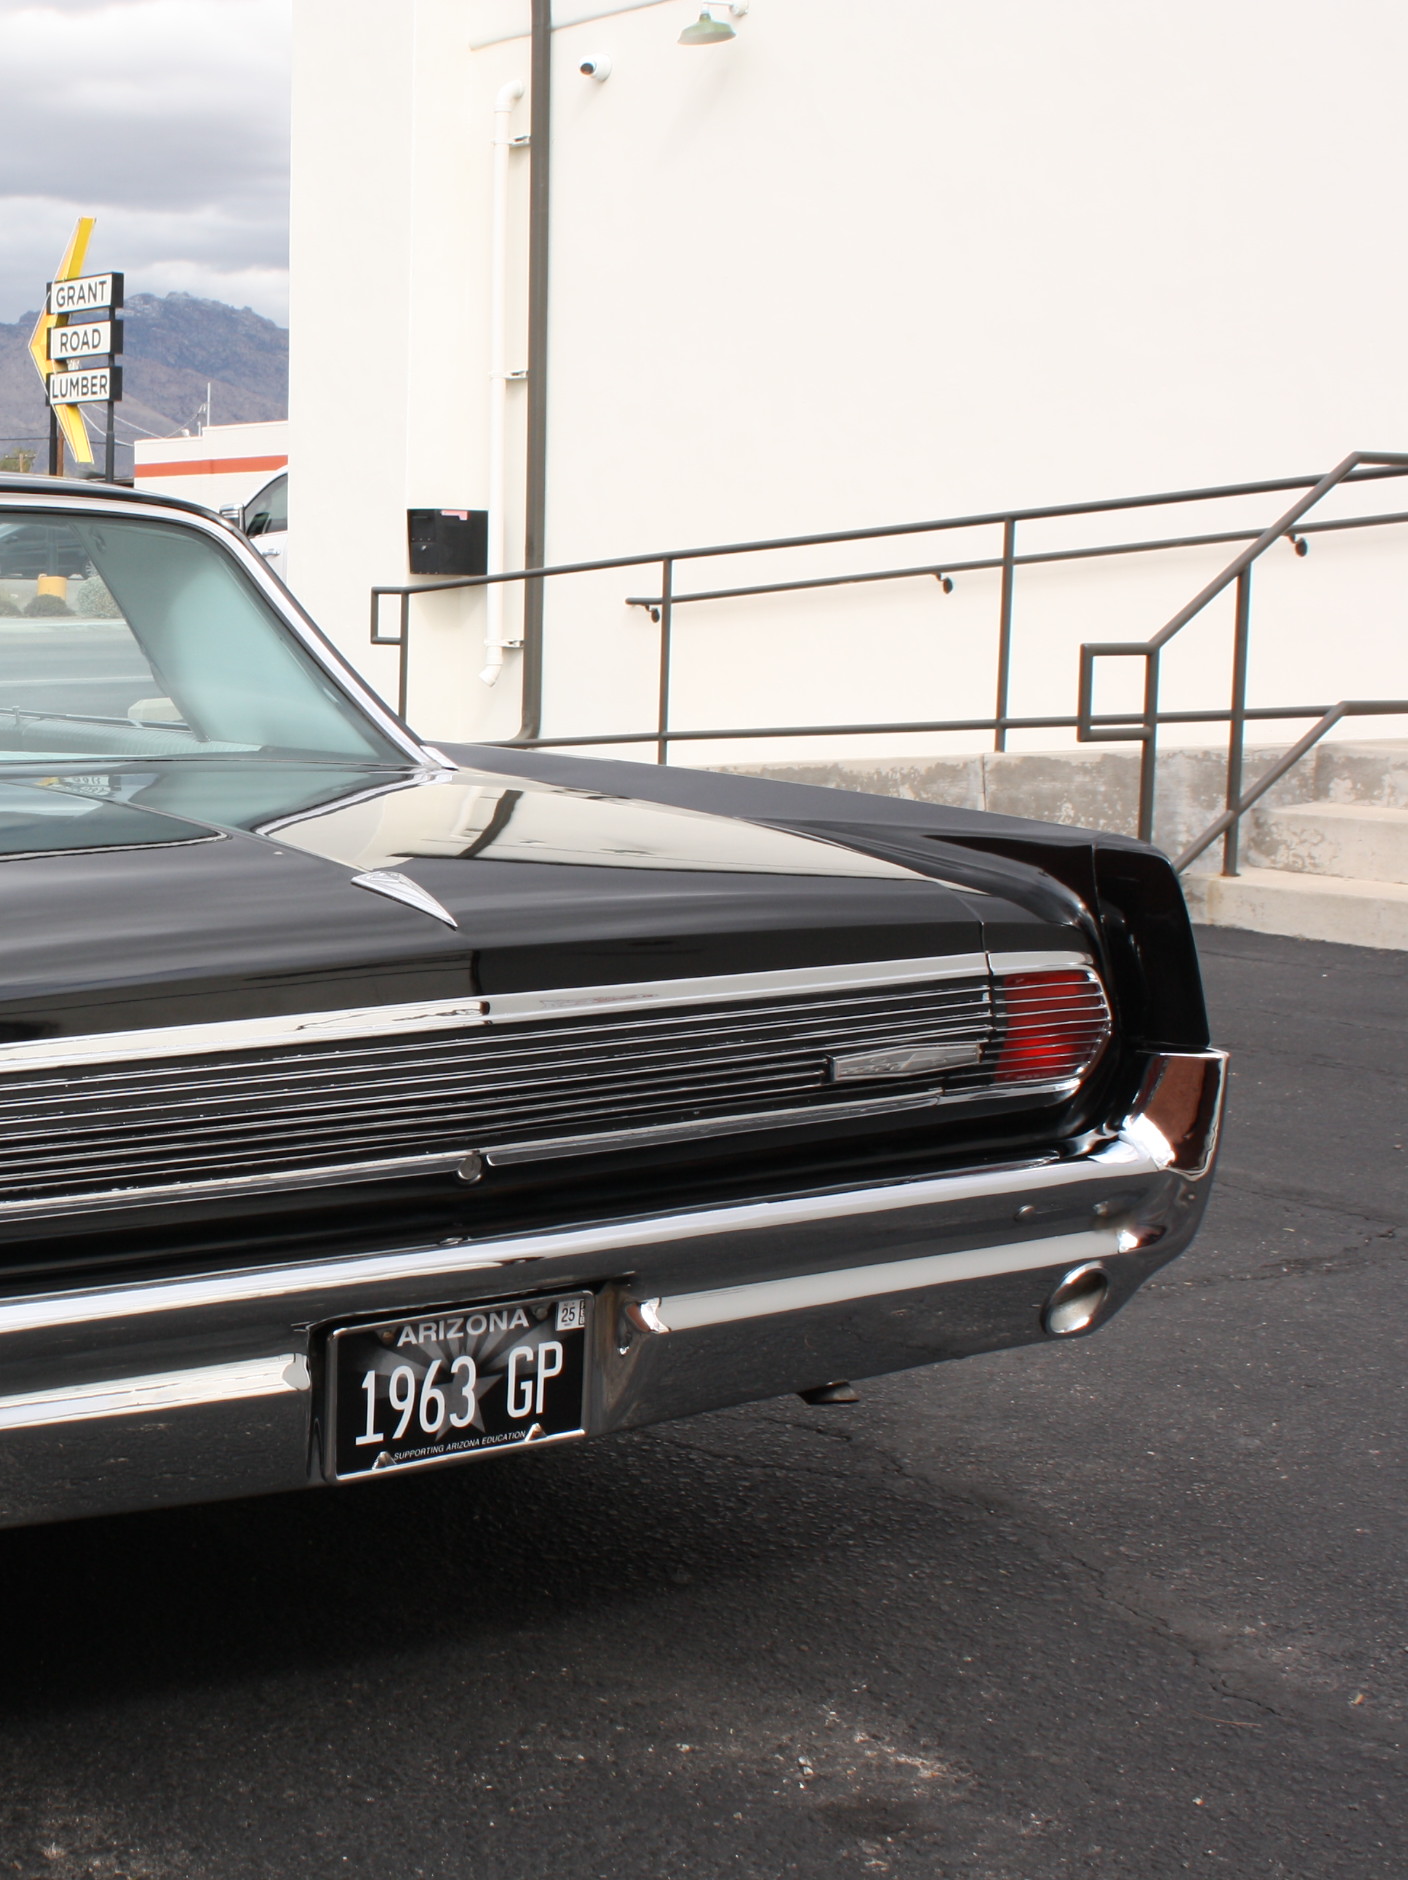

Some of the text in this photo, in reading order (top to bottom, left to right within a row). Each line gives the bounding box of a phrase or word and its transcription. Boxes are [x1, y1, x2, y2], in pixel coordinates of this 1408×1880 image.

[56, 281, 107, 308] GRANT
[60, 328, 101, 353] ROAD
[52, 374, 108, 399] LUMBER
[396, 1308, 530, 1348] ARIZONA
[561, 1306, 575, 1323] 25
[355, 1340, 564, 1446] 1963 GP
[394, 1430, 527, 1461] SUPPORTING ARIZONA EDUCATION
